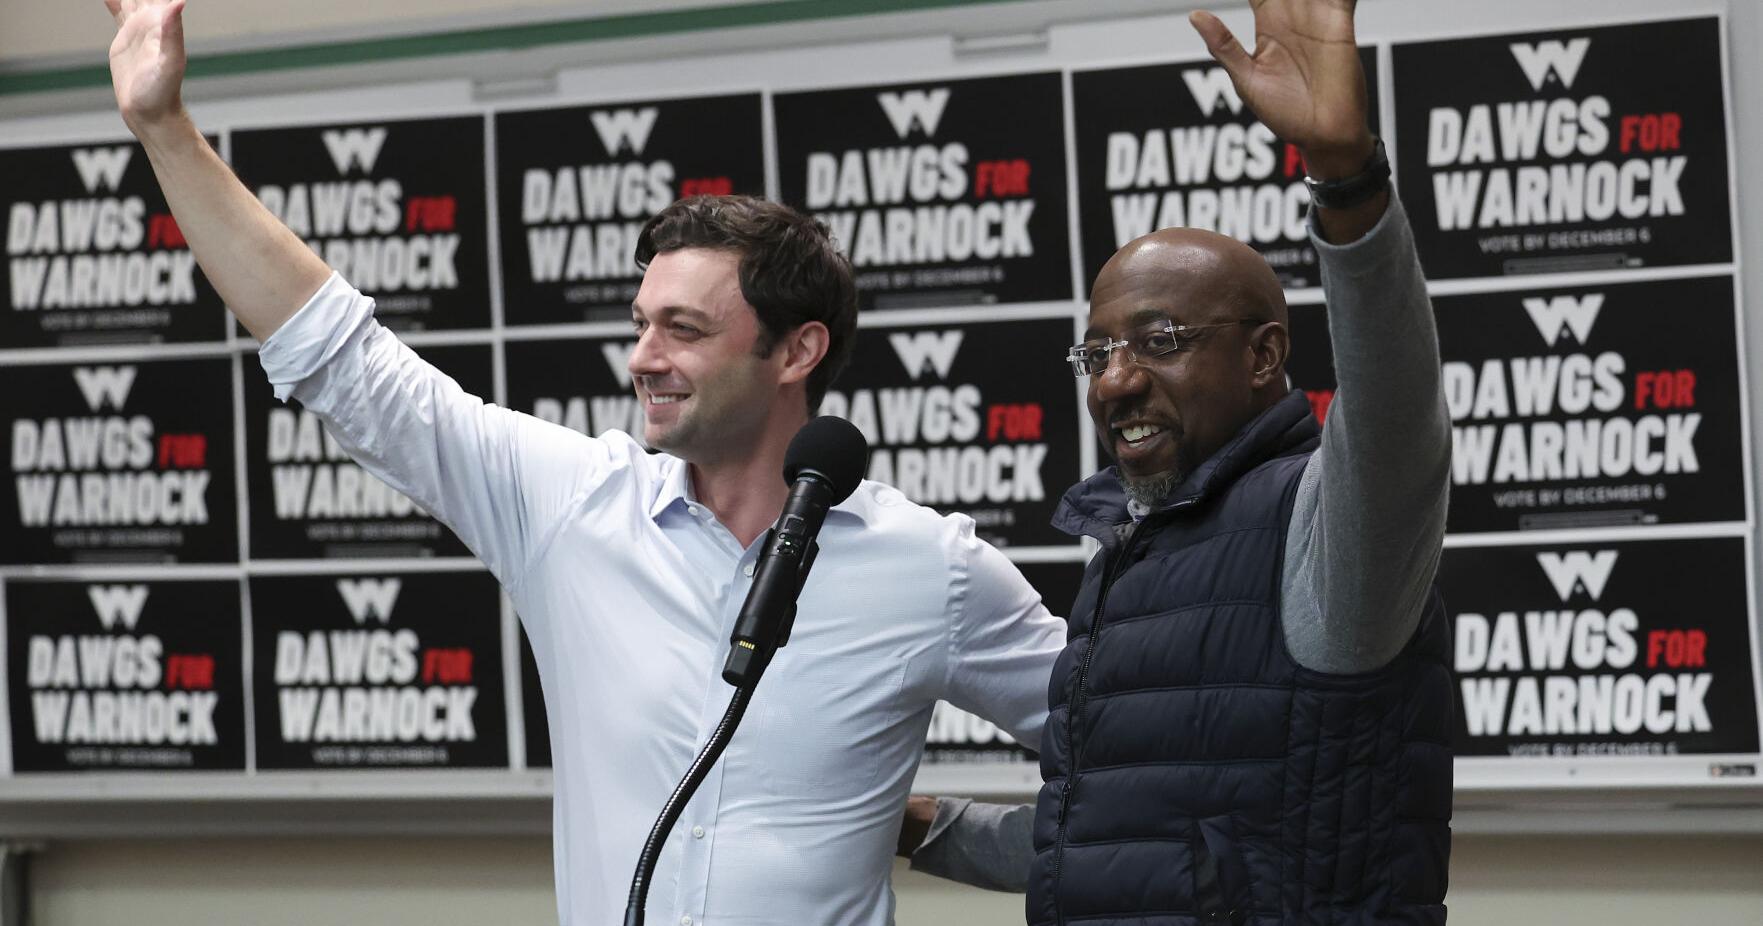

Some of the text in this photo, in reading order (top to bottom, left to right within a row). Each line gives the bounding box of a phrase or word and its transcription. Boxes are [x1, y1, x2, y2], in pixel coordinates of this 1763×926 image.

[1105, 121, 1277, 191] DAWGS
[1427, 96, 1682, 167] DAWGS FOR
[522, 160, 675, 225] DAWGS
[805, 142, 1031, 209] DAWGS FOR
[1432, 156, 1688, 231] WARNOCK
[7, 196, 146, 255] DAWGS
[406, 194, 459, 233] FOR
[1111, 181, 1311, 250] WARNOC
[1478, 235, 1521, 253] VOTE
[1523, 233, 1545, 251] BY
[1548, 228, 1637, 249] DECEMBER
[10, 249, 196, 311] WARNOCK
[306, 233, 460, 292] RNOCK
[1443, 351, 1696, 421] DAWGS FOR
[12, 415, 154, 472] DAWGS
[987, 402, 1043, 442] FOR
[1452, 413, 1701, 486] WARNOCK
[16, 469, 210, 527] WARNOCK
[866, 443, 1048, 505] ARNOCK
[1493, 490, 1536, 508] VOTE
[1563, 483, 1652, 505] DECEMBER
[27, 635, 215, 690] DAWGS FOR
[274, 629, 474, 685] DAWGS FOR
[1454, 608, 1708, 673] DAWGS FOR
[31, 692, 218, 746] WARNOCK
[279, 687, 478, 742] WARNOCK
[1461, 673, 1713, 736] WARNOCK
